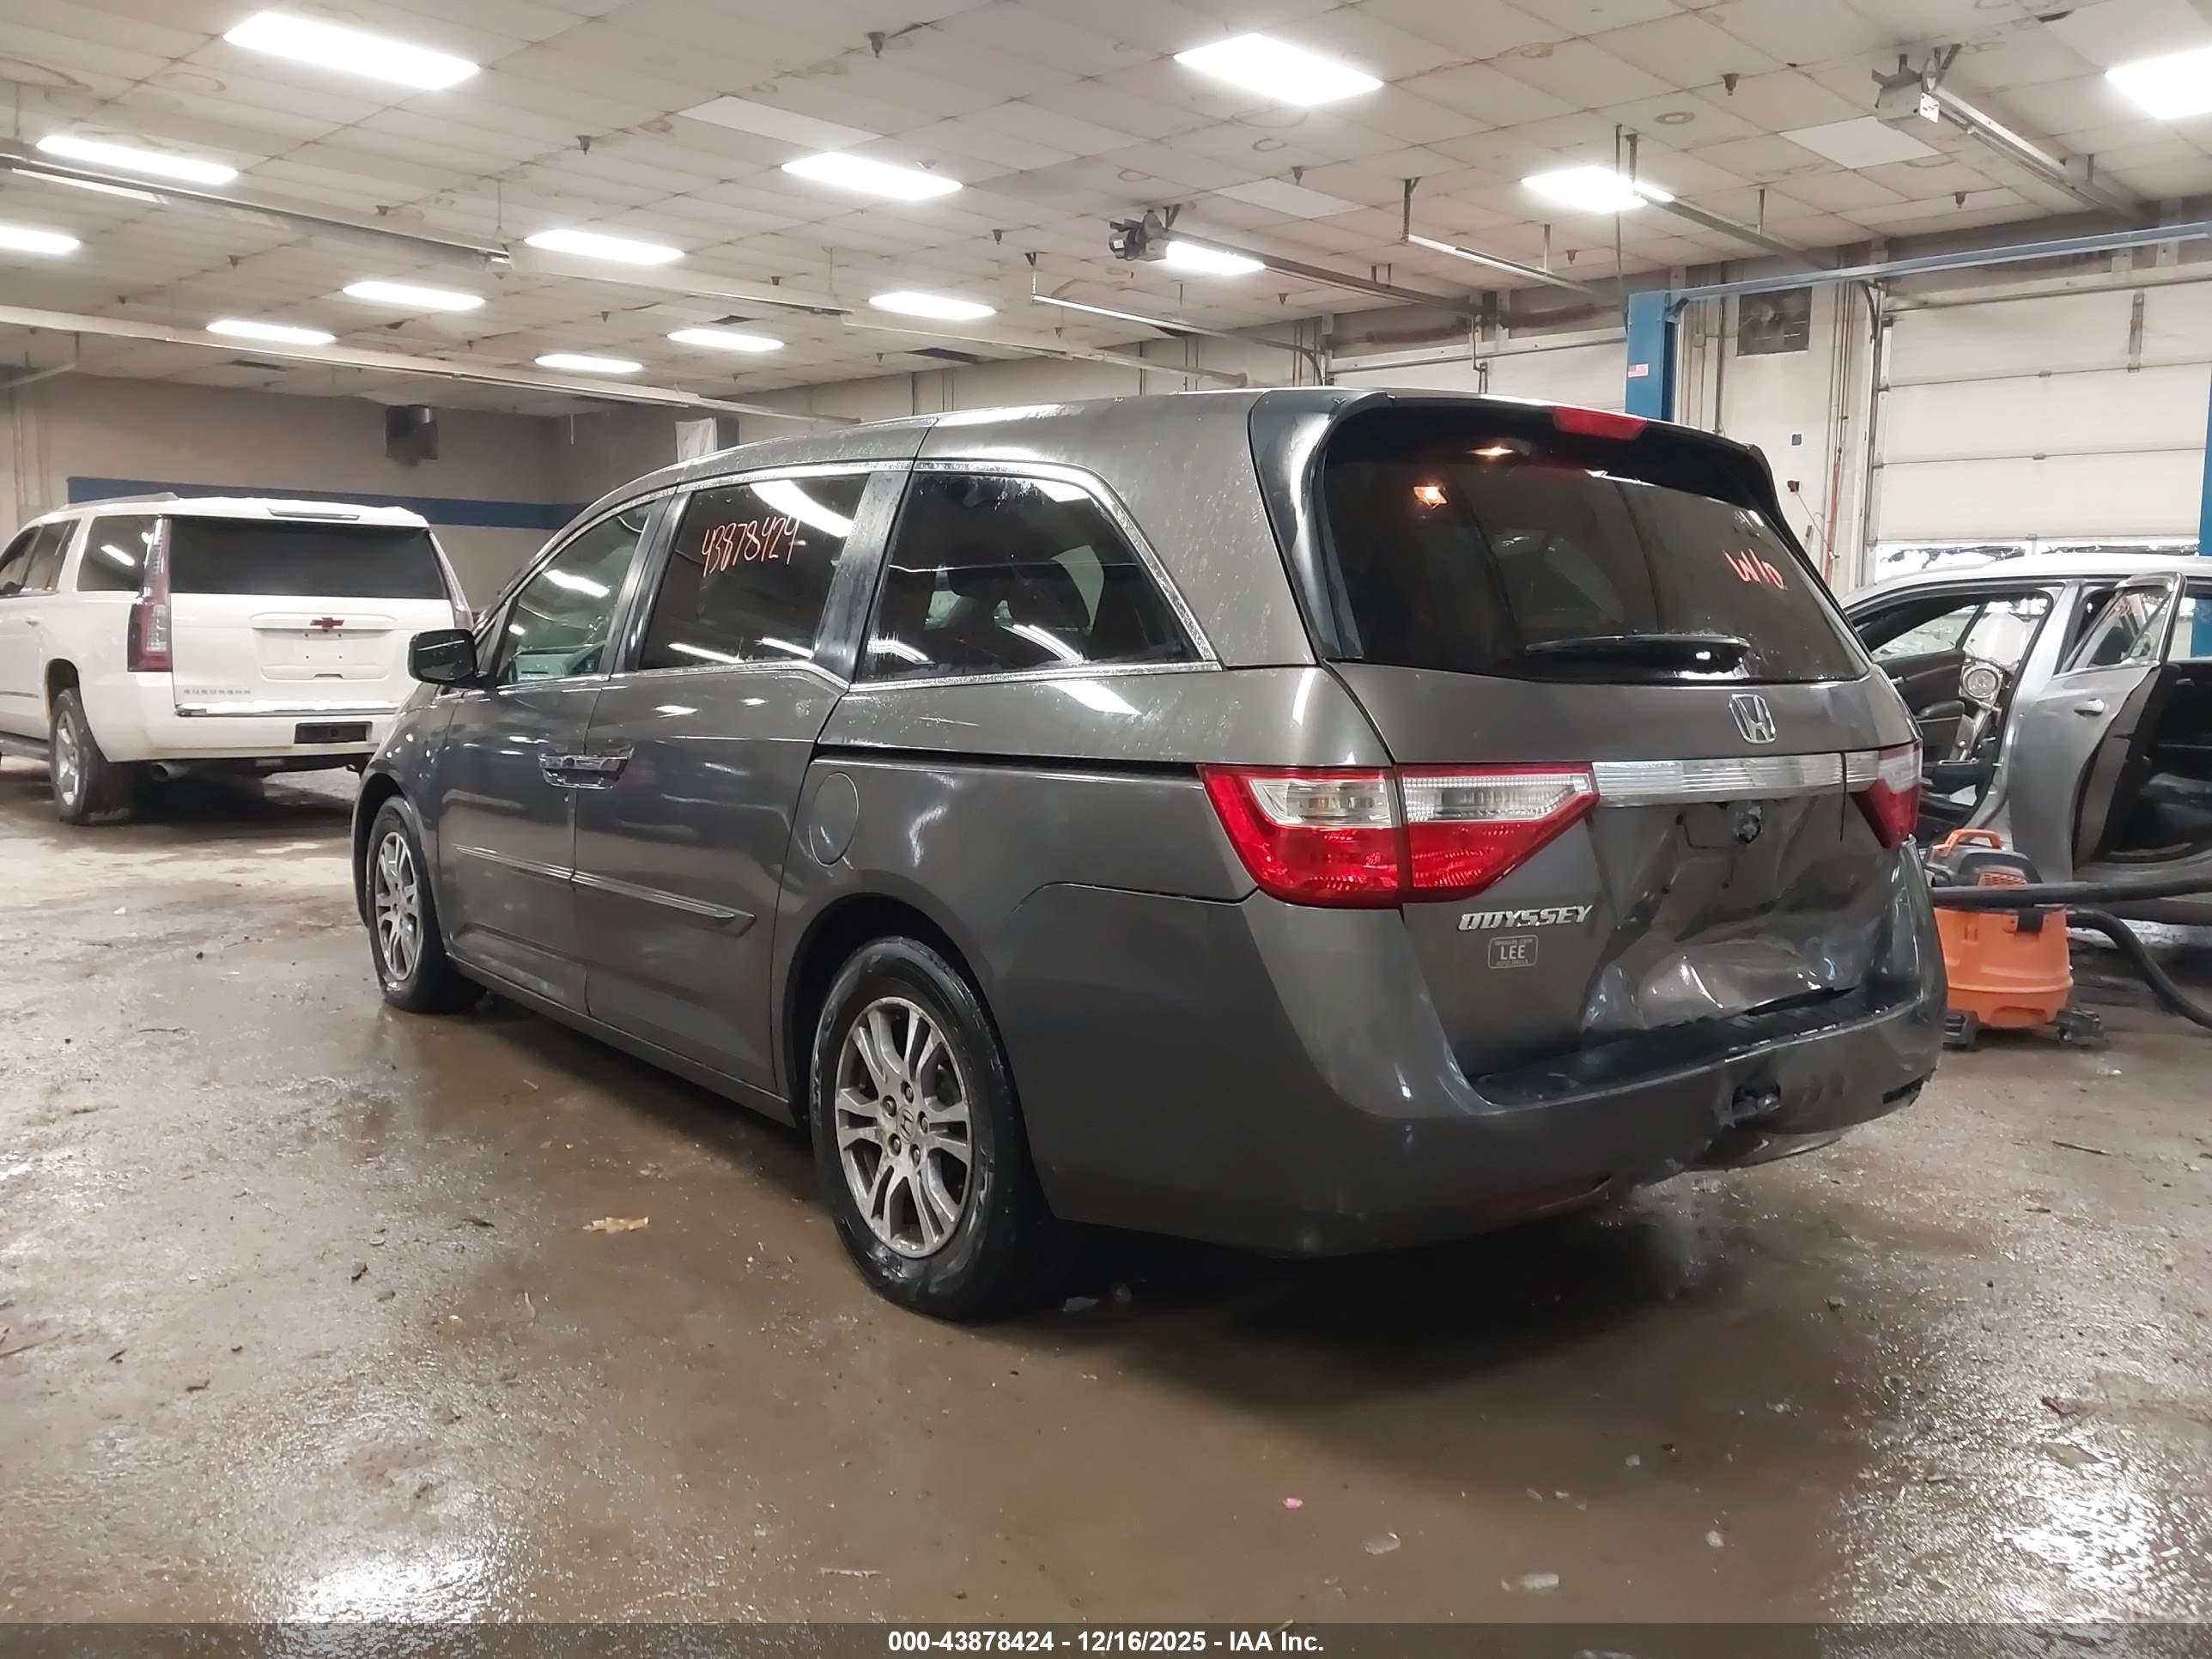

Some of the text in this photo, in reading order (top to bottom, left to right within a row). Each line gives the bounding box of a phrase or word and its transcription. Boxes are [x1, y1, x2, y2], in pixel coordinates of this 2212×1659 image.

[702, 515, 800, 577] 43878424
[1458, 904, 1594, 931] ODYSSEY
[1500, 945, 1526, 961] LEE
